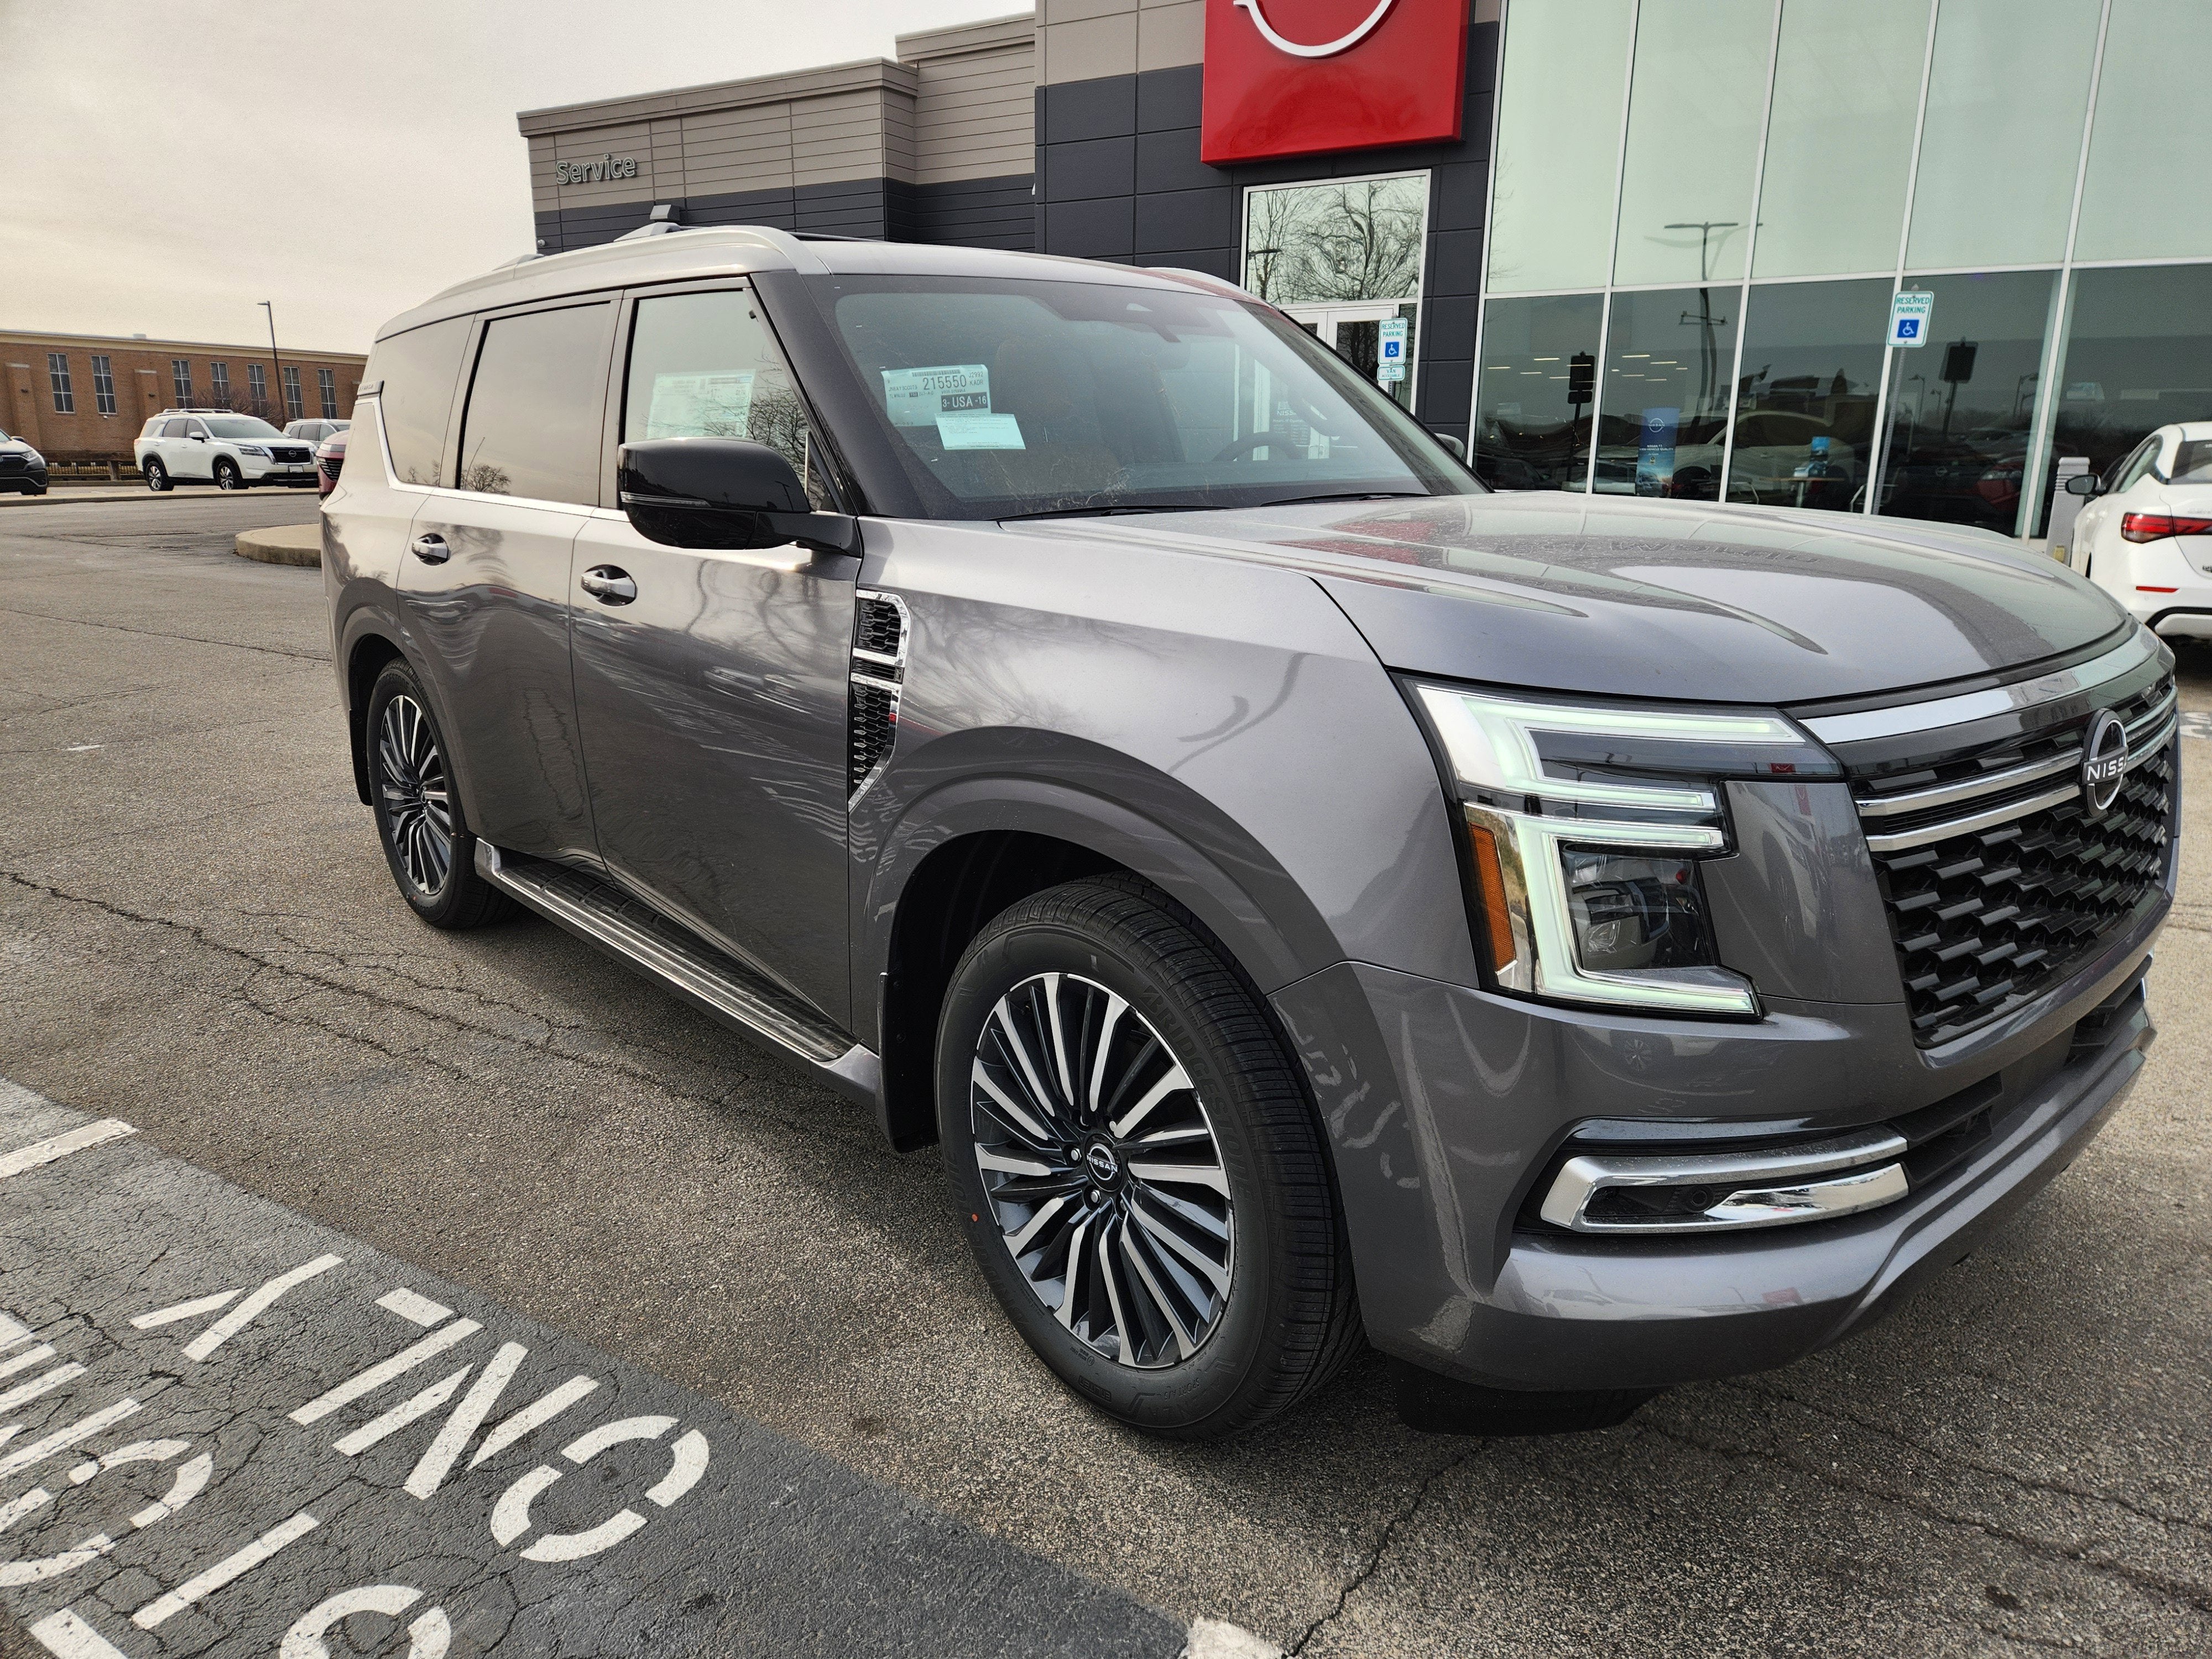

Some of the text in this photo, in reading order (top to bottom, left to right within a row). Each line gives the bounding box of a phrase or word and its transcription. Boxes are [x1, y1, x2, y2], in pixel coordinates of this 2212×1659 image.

[556, 153, 636, 184] Service
[922, 374, 967, 390] 215550
[952, 395, 973, 408] USA
[974, 395, 987, 404] -16
[2087, 755, 2127, 781] NISS
[1140, 979, 1256, 1203] BRIDGESTONE
[1086, 1154, 1118, 1172] NISSAN
[130, 1253, 710, 1562] ONLY
